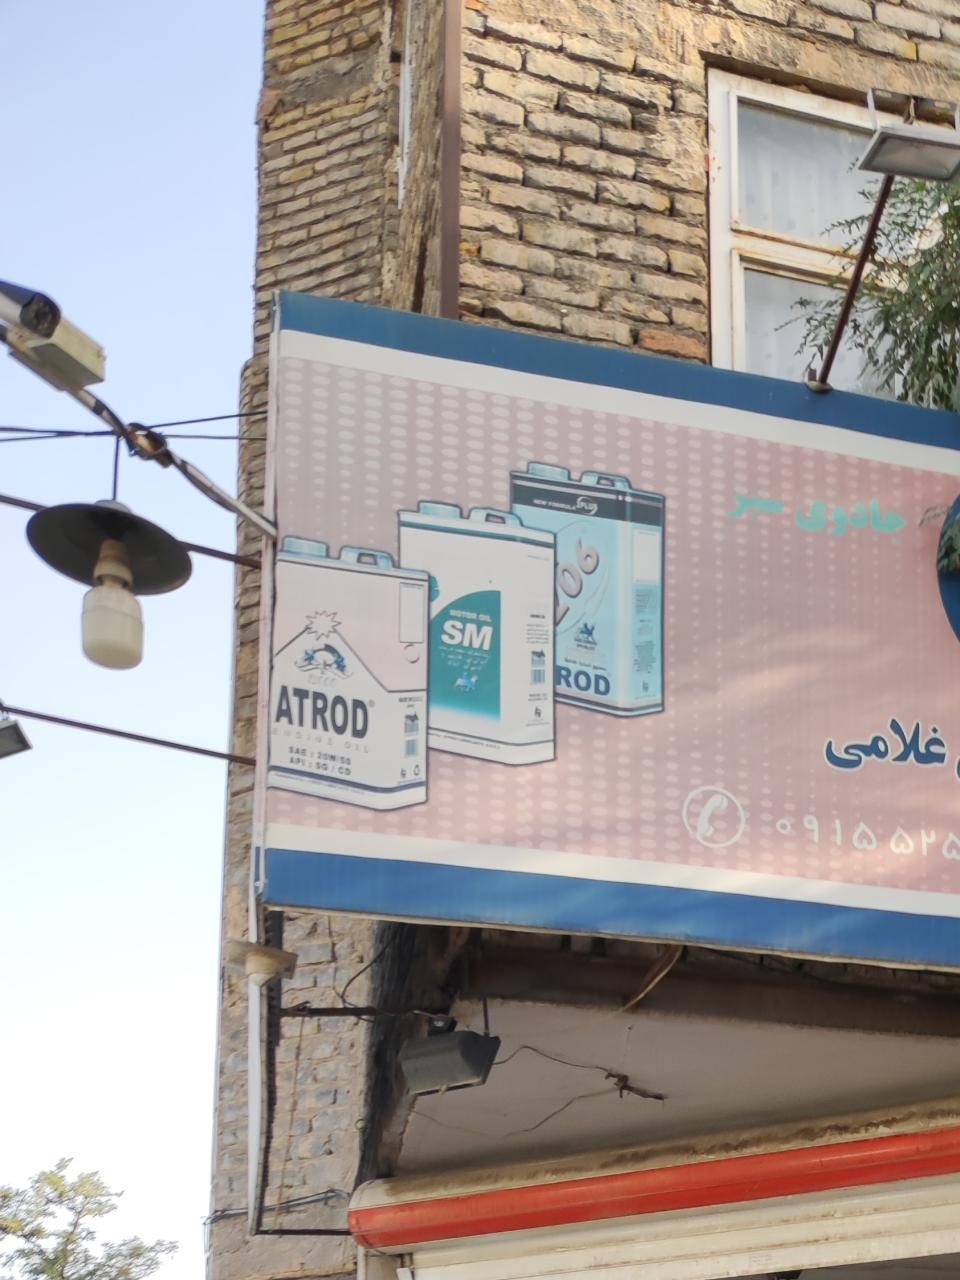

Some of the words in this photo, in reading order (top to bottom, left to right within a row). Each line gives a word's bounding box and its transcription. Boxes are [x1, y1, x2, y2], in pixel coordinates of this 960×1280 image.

[796, 499, 907, 542] جادوی
[556, 537, 600, 627] 06
[441, 620, 494, 651] SM
[556, 665, 612, 697] ROD
[275, 685, 369, 739] ATROD
[824, 717, 947, 770] غلامی
[774, 815, 877, 851] ۰۹۱۵
